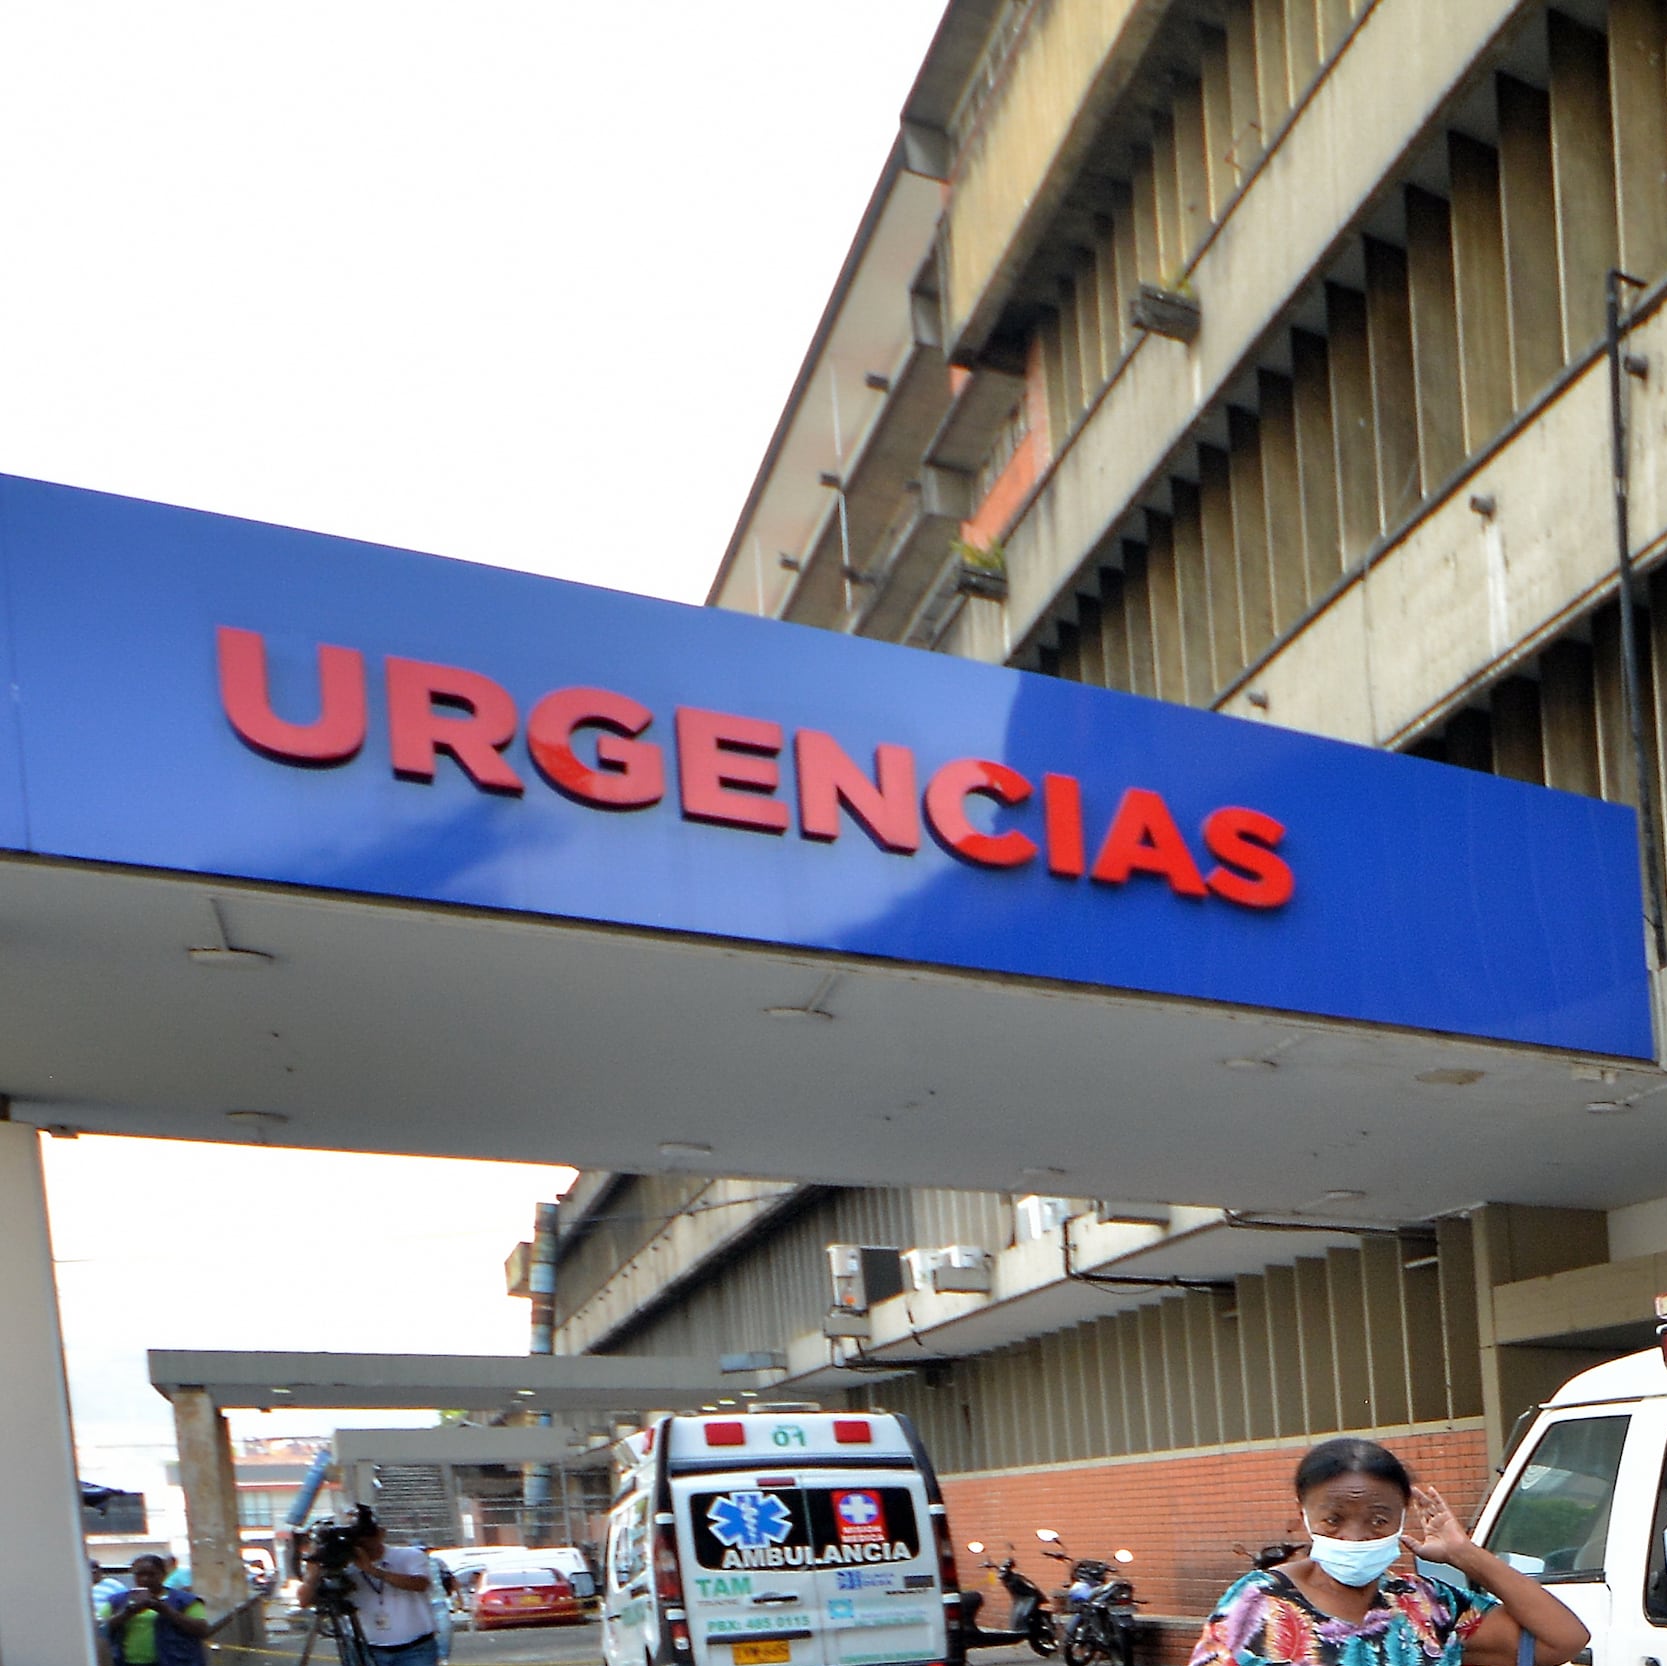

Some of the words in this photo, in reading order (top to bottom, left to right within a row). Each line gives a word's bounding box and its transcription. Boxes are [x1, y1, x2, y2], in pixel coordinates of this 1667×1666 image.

[216, 626, 1295, 908] URGENCIAS
[722, 1541, 912, 1569] AMBULANCIA
[695, 1577, 752, 1598] TAM
